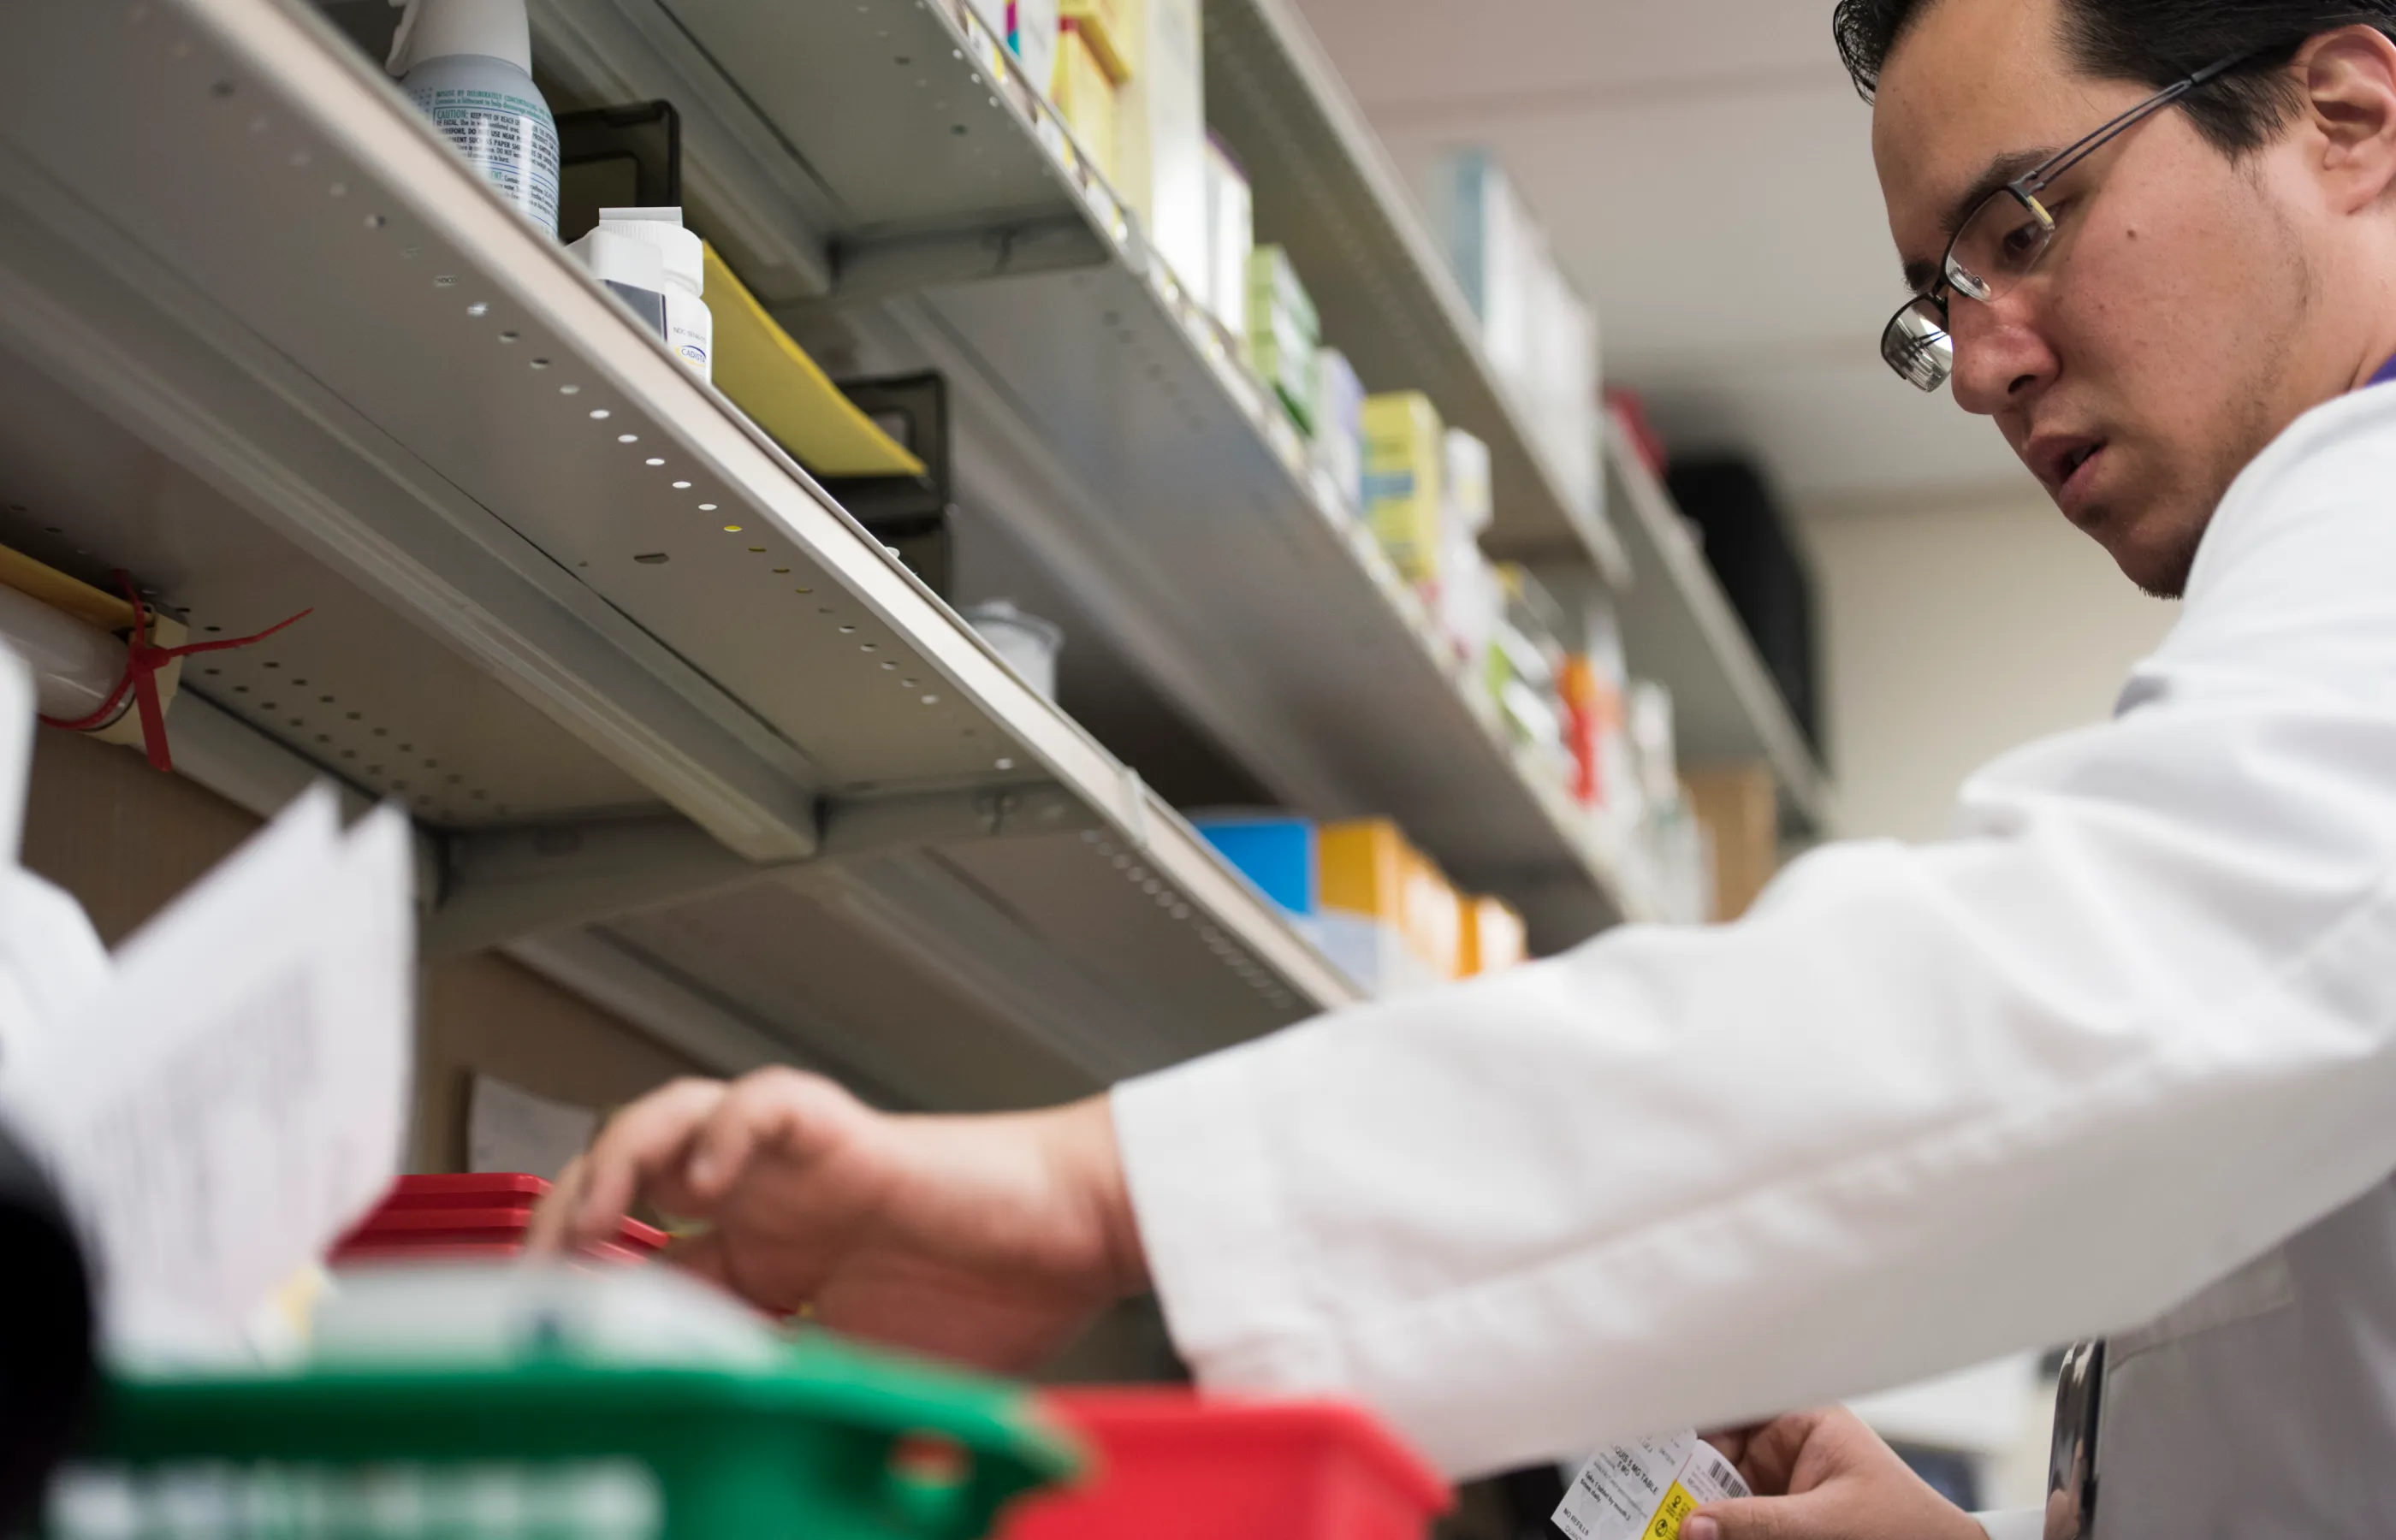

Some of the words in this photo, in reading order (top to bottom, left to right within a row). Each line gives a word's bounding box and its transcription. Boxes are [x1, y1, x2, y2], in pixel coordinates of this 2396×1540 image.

[437, 110, 468, 120] CAUTION:
[494, 139, 511, 148] PAPER
[502, 133, 515, 142] NEAR
[681, 348, 705, 364] CADISTA
[1621, 1465, 1630, 1477] MG
[1632, 1463, 1642, 1477] MG
[1640, 1472, 1660, 1496] TABLE
[1585, 1471, 1595, 1484] Take
[1598, 1484, 1610, 1499] tablet
[1608, 1496, 1615, 1506] by
[1563, 1507, 1572, 1519] NO
[1570, 1514, 1589, 1537] REFILLS
